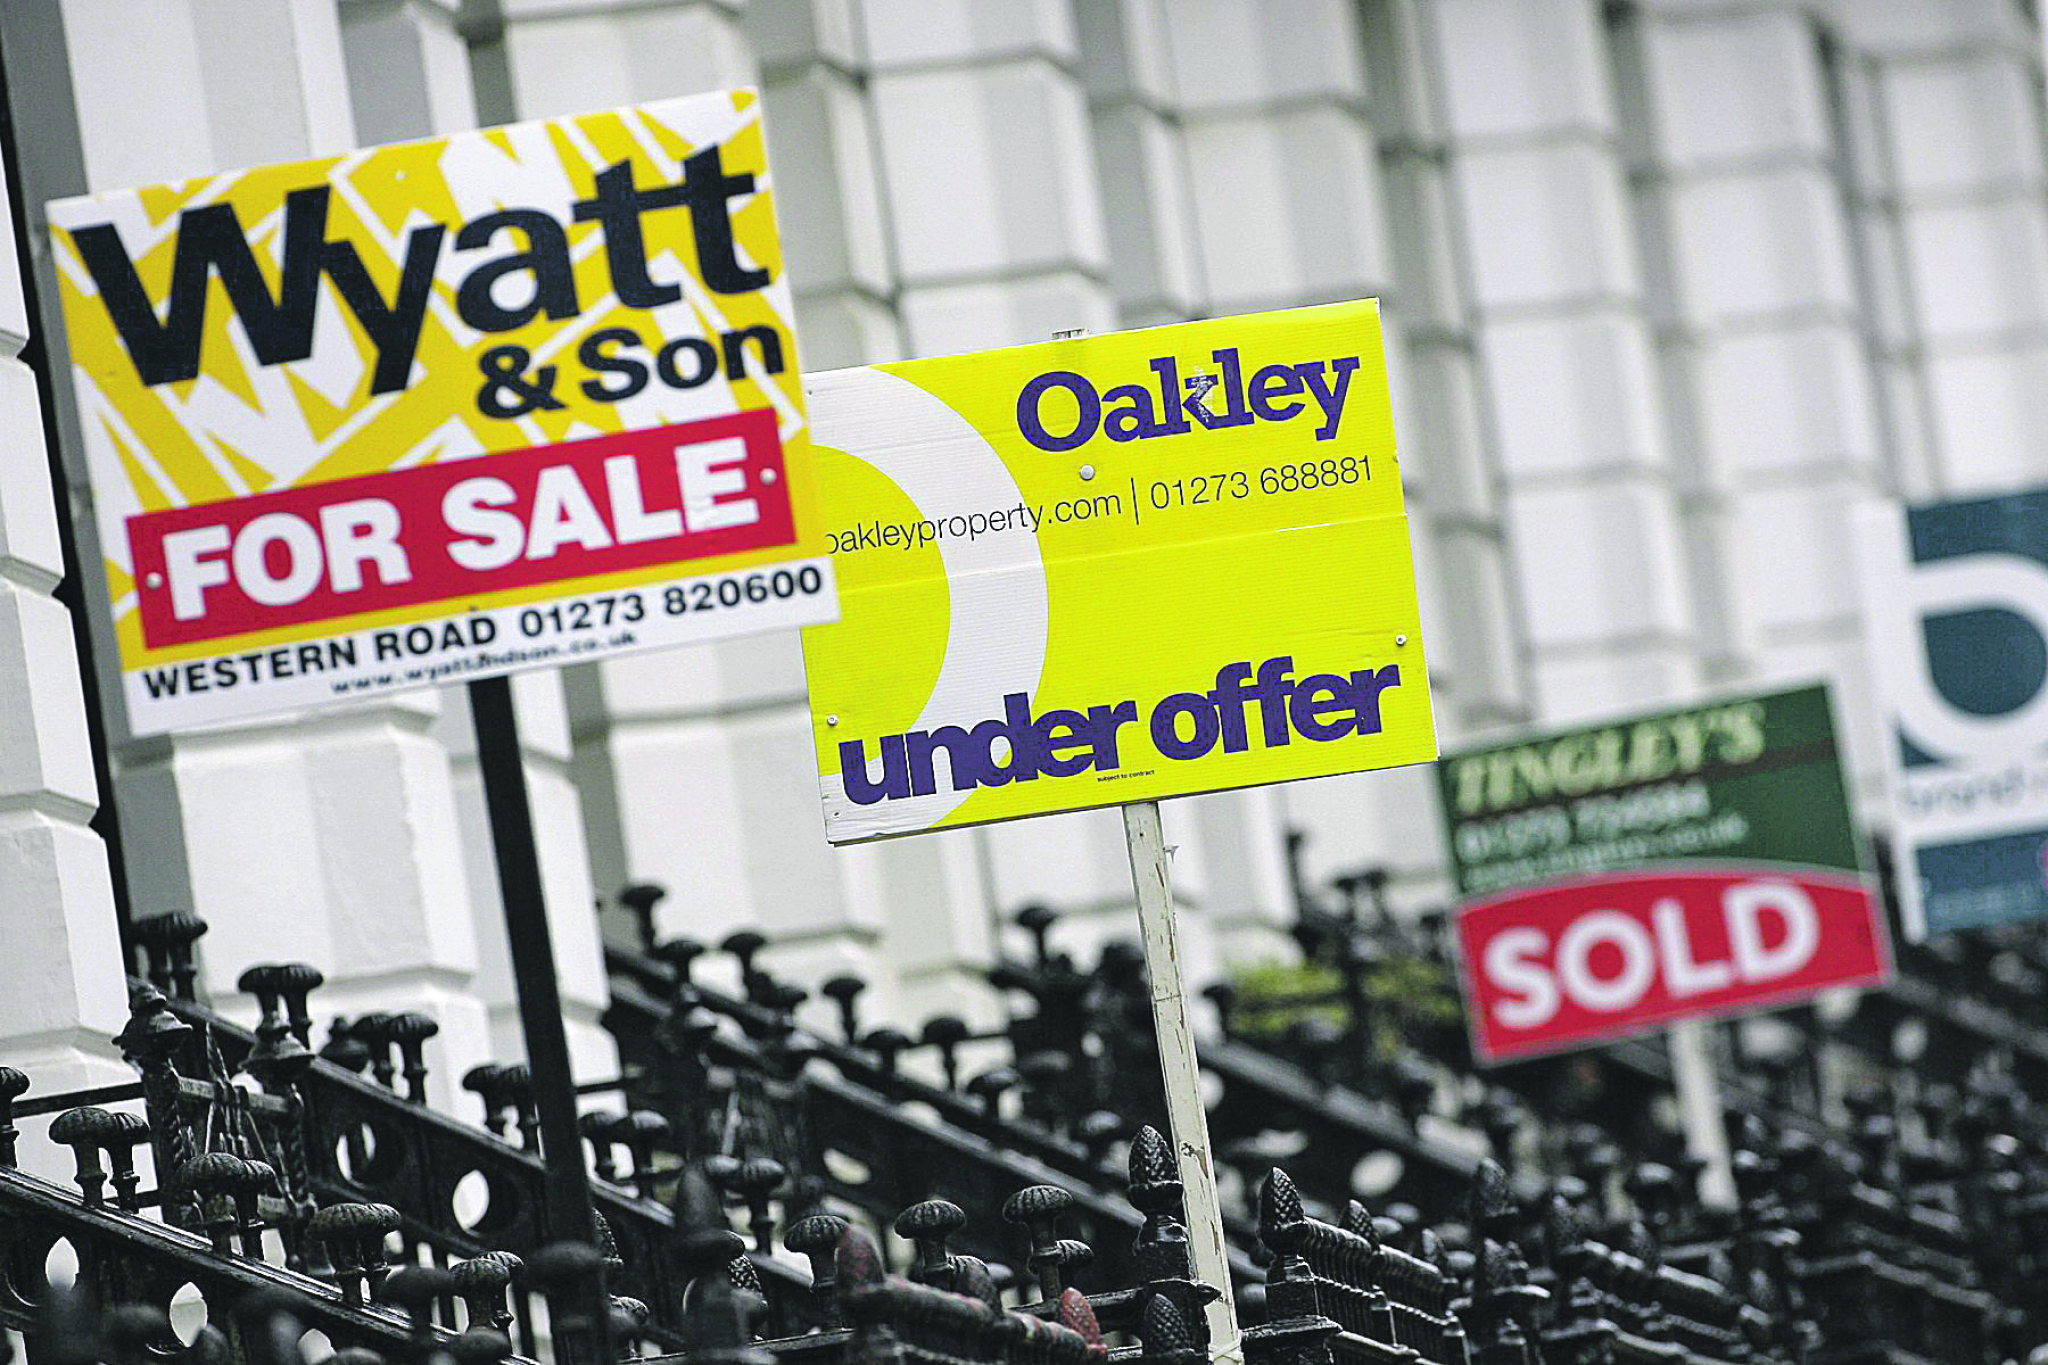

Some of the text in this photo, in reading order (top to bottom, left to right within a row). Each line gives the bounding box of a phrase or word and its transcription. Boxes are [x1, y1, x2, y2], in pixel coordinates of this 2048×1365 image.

[69, 145, 771, 397] Wyatt
[477, 325, 786, 420] & Son
[1016, 347, 1360, 452] Oakley
[163, 437, 759, 620] FOR SALE
[1150, 471, 1250, 509] 01273
[1260, 454, 1372, 495] 688881
[144, 566, 823, 699] WESTERN ROAD 01273 820600
[838, 655, 1401, 806] under offer
[1484, 877, 1819, 1028] SOLD
